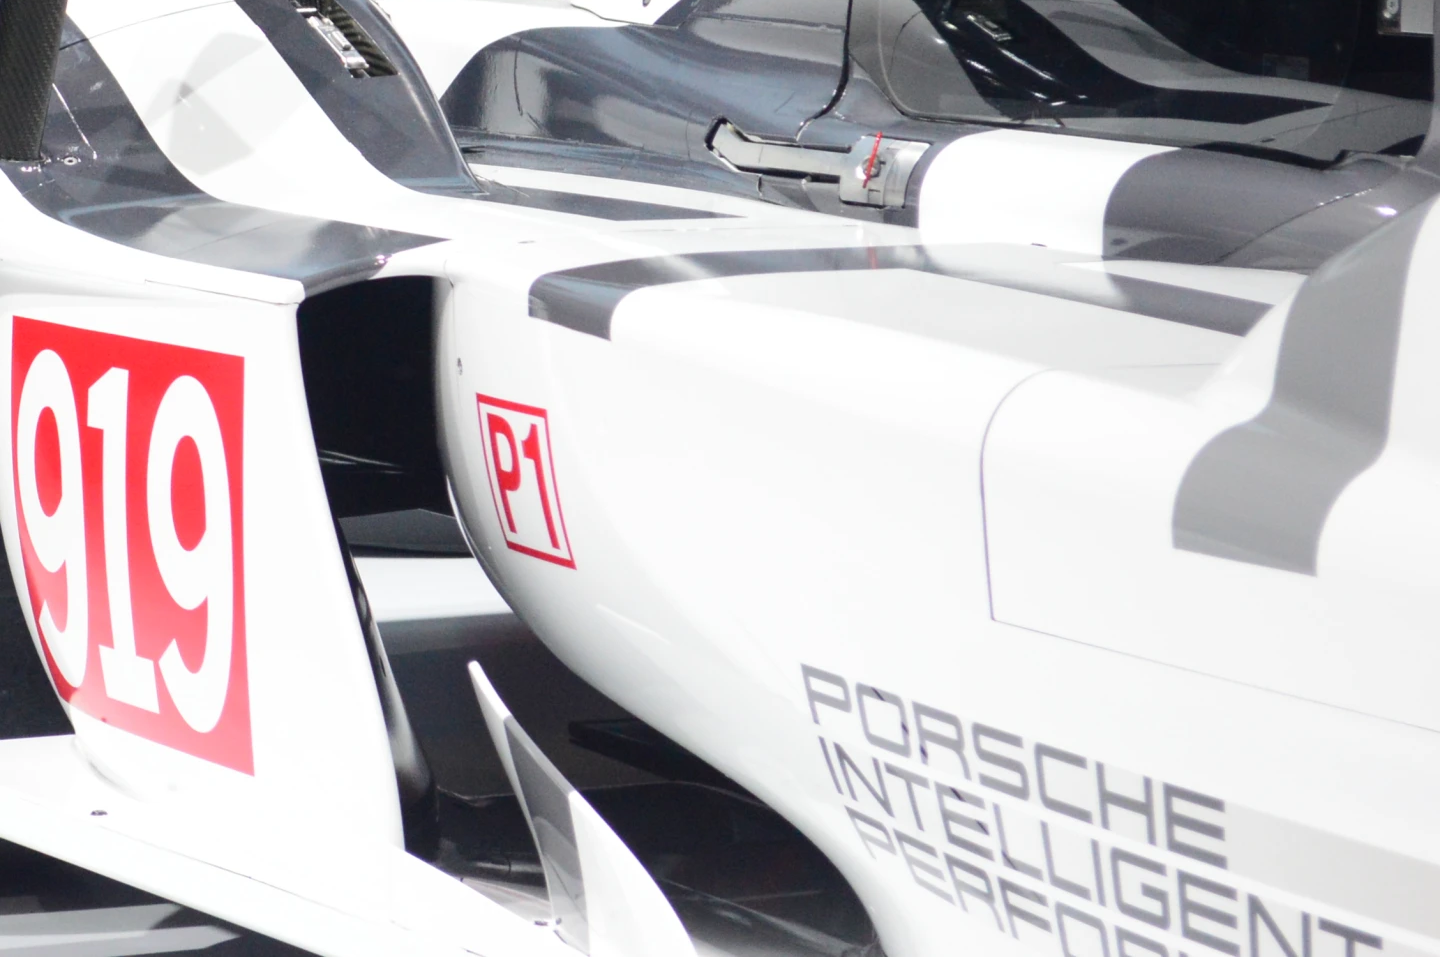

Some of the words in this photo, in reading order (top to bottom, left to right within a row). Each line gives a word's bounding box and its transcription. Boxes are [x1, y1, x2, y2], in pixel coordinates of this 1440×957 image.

[16, 348, 235, 734] 919
[486, 411, 562, 551] P1
[800, 662, 1228, 871] PORSCHE
[817, 735, 1384, 957] INTELLIGENT
[843, 804, 1193, 957] PERFO
